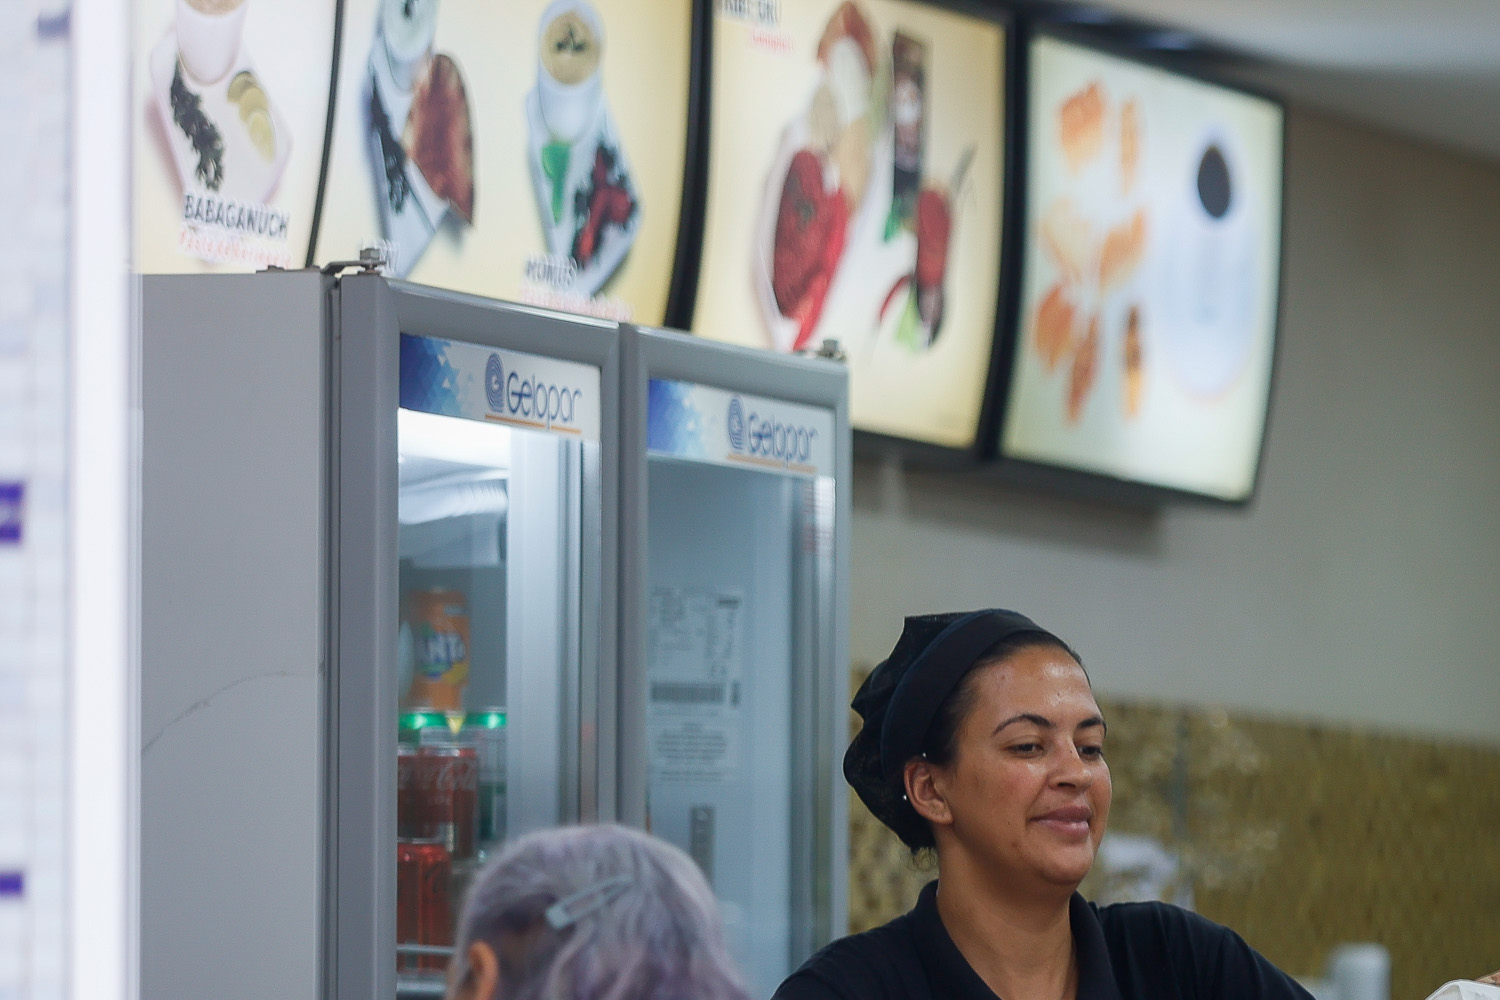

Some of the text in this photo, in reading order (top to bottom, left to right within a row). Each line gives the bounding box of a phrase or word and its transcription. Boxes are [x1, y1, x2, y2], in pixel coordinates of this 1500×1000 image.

[183, 194, 290, 239] BABAGANUCH
[506, 371, 582, 432] Gelopar
[748, 412, 819, 470] Gelopar
